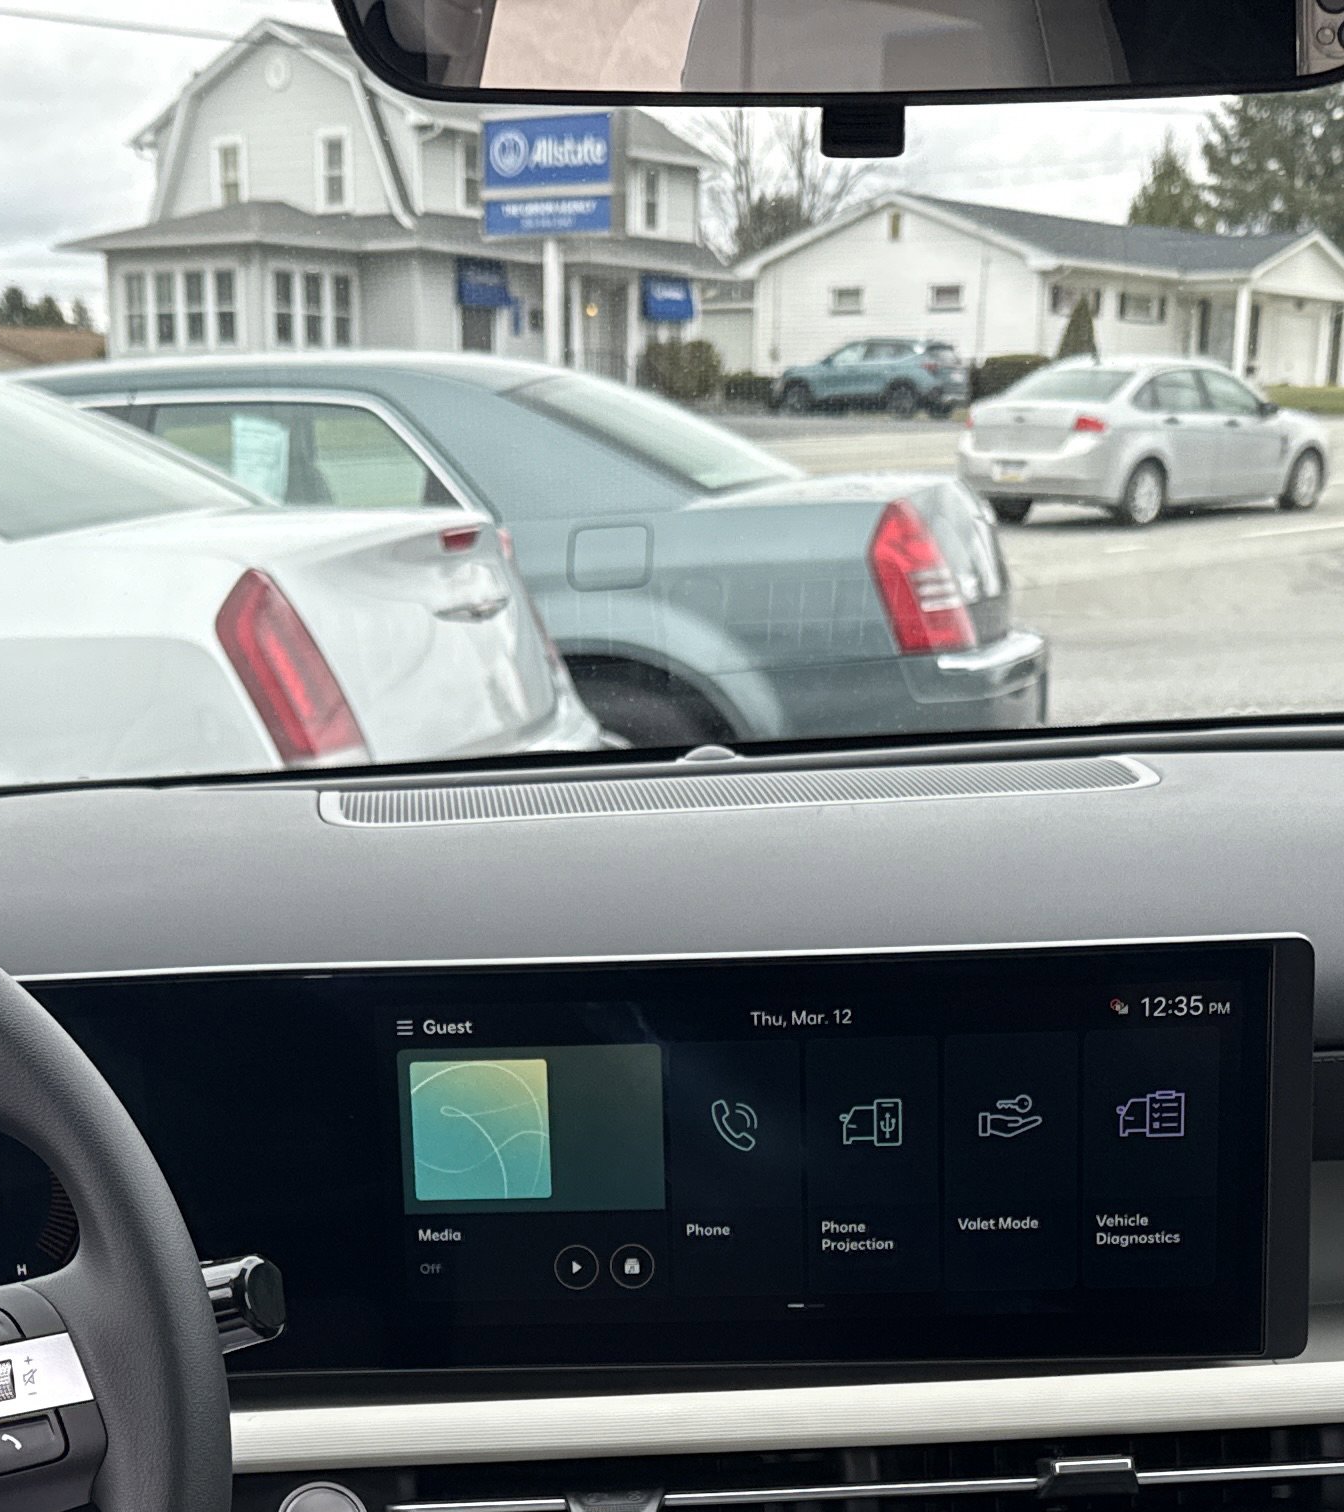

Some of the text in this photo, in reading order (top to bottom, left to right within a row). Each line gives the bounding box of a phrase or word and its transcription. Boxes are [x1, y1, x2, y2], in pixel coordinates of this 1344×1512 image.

[528, 133, 607, 171] Allstate
[1140, 995, 1231, 1017] 12:35 PM
[750, 1008, 853, 1028] Thu, Mar. 12
[423, 1019, 473, 1035] Guest
[821, 1221, 866, 1234] Phone
[957, 1216, 1039, 1231] Valet Mode
[1096, 1214, 1149, 1227] Vehicle
[418, 1229, 461, 1242] Media
[686, 1223, 731, 1236] Phone
[821, 1238, 894, 1252] Projection
[1096, 1231, 1181, 1248] Diagnostics
[17, 1264, 27, 1276] H
[420, 1263, 442, 1274] Off
